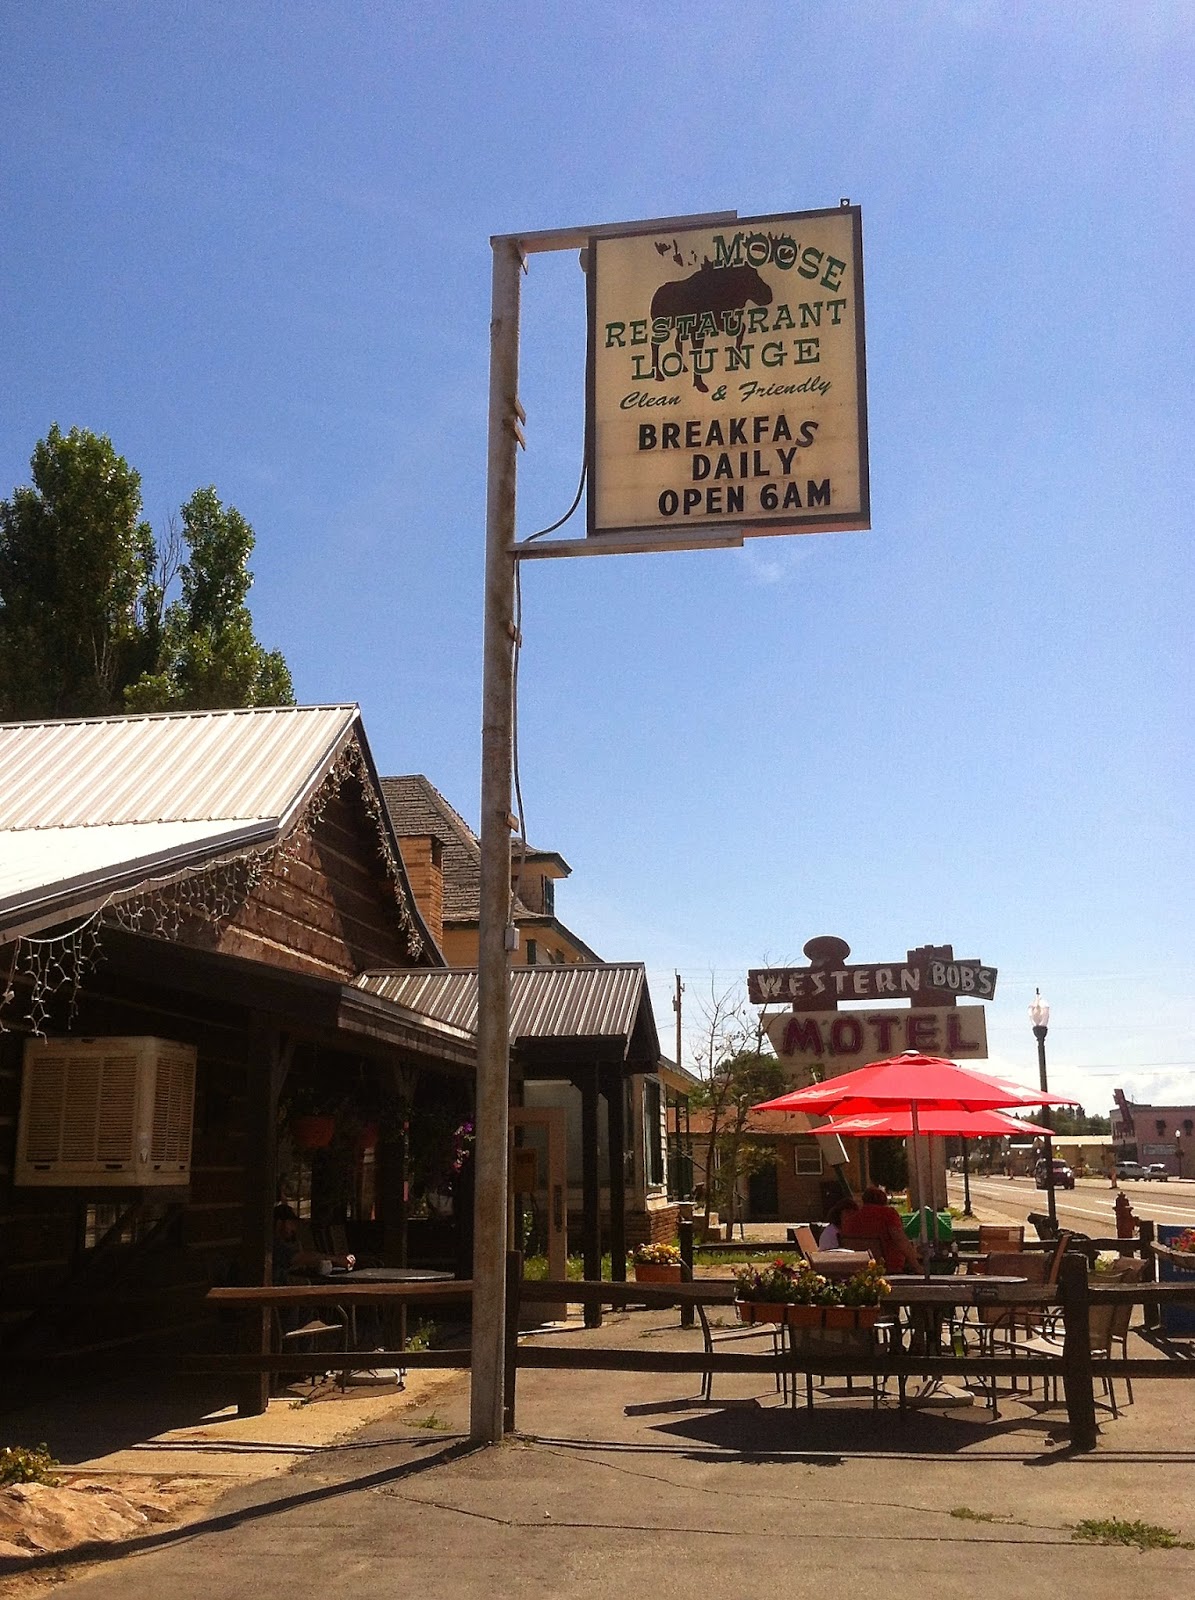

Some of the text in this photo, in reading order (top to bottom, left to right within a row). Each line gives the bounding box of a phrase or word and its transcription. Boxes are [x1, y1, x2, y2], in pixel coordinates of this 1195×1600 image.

[712, 233, 847, 293] MOOSE
[605, 298, 847, 348] RESTAURANT
[631, 338, 820, 380] LOUNGE
[619, 376, 832, 410] Clean & Friendly
[638, 414, 819, 450] BREAKFAS
[692, 447, 797, 481] DAILY
[658, 478, 831, 516] OPEN 6AM
[757, 960, 991, 998] WESTERN BOB'S
[782, 1013, 979, 1057] MOTEL
